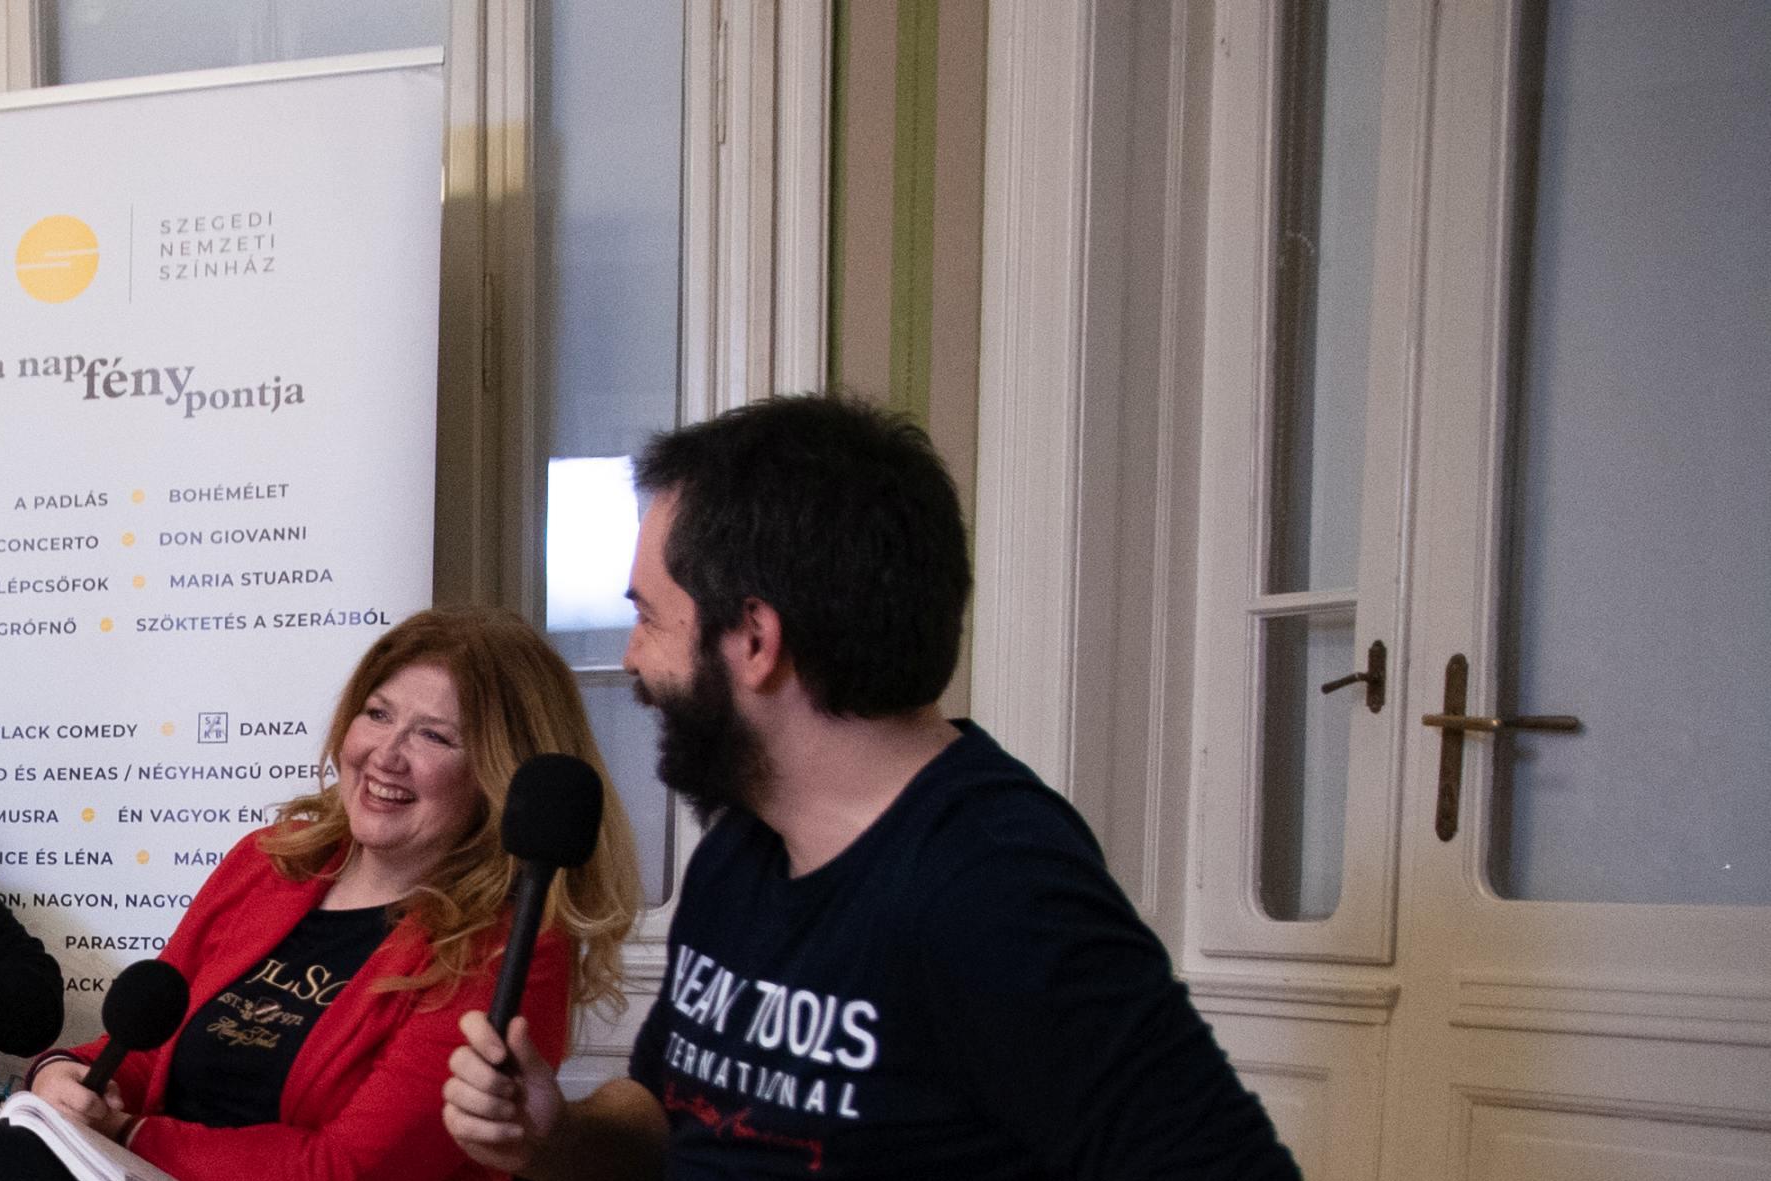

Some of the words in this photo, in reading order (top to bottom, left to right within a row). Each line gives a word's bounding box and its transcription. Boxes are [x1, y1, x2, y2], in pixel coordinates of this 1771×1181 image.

[160, 211, 274, 236] SZEGEDI
[160, 233, 275, 258] NEMZETI
[159, 255, 275, 280] SZÍNHÁZ
[13, 496, 27, 511] A
[33, 490, 109, 510] PADLÁS
[168, 482, 290, 504] BOHÉMÉLET
[159, 531, 203, 547] DON
[210, 525, 307, 545] GIOVANNI
[169, 573, 235, 589] MARIA
[240, 568, 334, 587] STUARDA
[135, 612, 248, 633] SZÖKTETÉS
[253, 614, 267, 629] A
[273, 608, 392, 629] SZERÁJBÓL
[56, 724, 138, 740] COMEDY
[239, 720, 308, 737] DANZA
[14, 764, 37, 782] ÉS
[42, 766, 119, 781] AENEAS
[138, 762, 262, 781] NÉGYHANGÚ
[269, 763, 336, 780] OPERA
[118, 806, 143, 823] ÉN
[149, 808, 231, 824] VAGYOK
[238, 805, 269, 825] ÉN,
[35, 848, 58, 866] ÉS
[64, 848, 114, 866] LÉNA
[32, 893, 118, 911] NAGYON,
[65, 936, 171, 951] PARASZTO
[745, 979, 878, 1071] TOOLS
